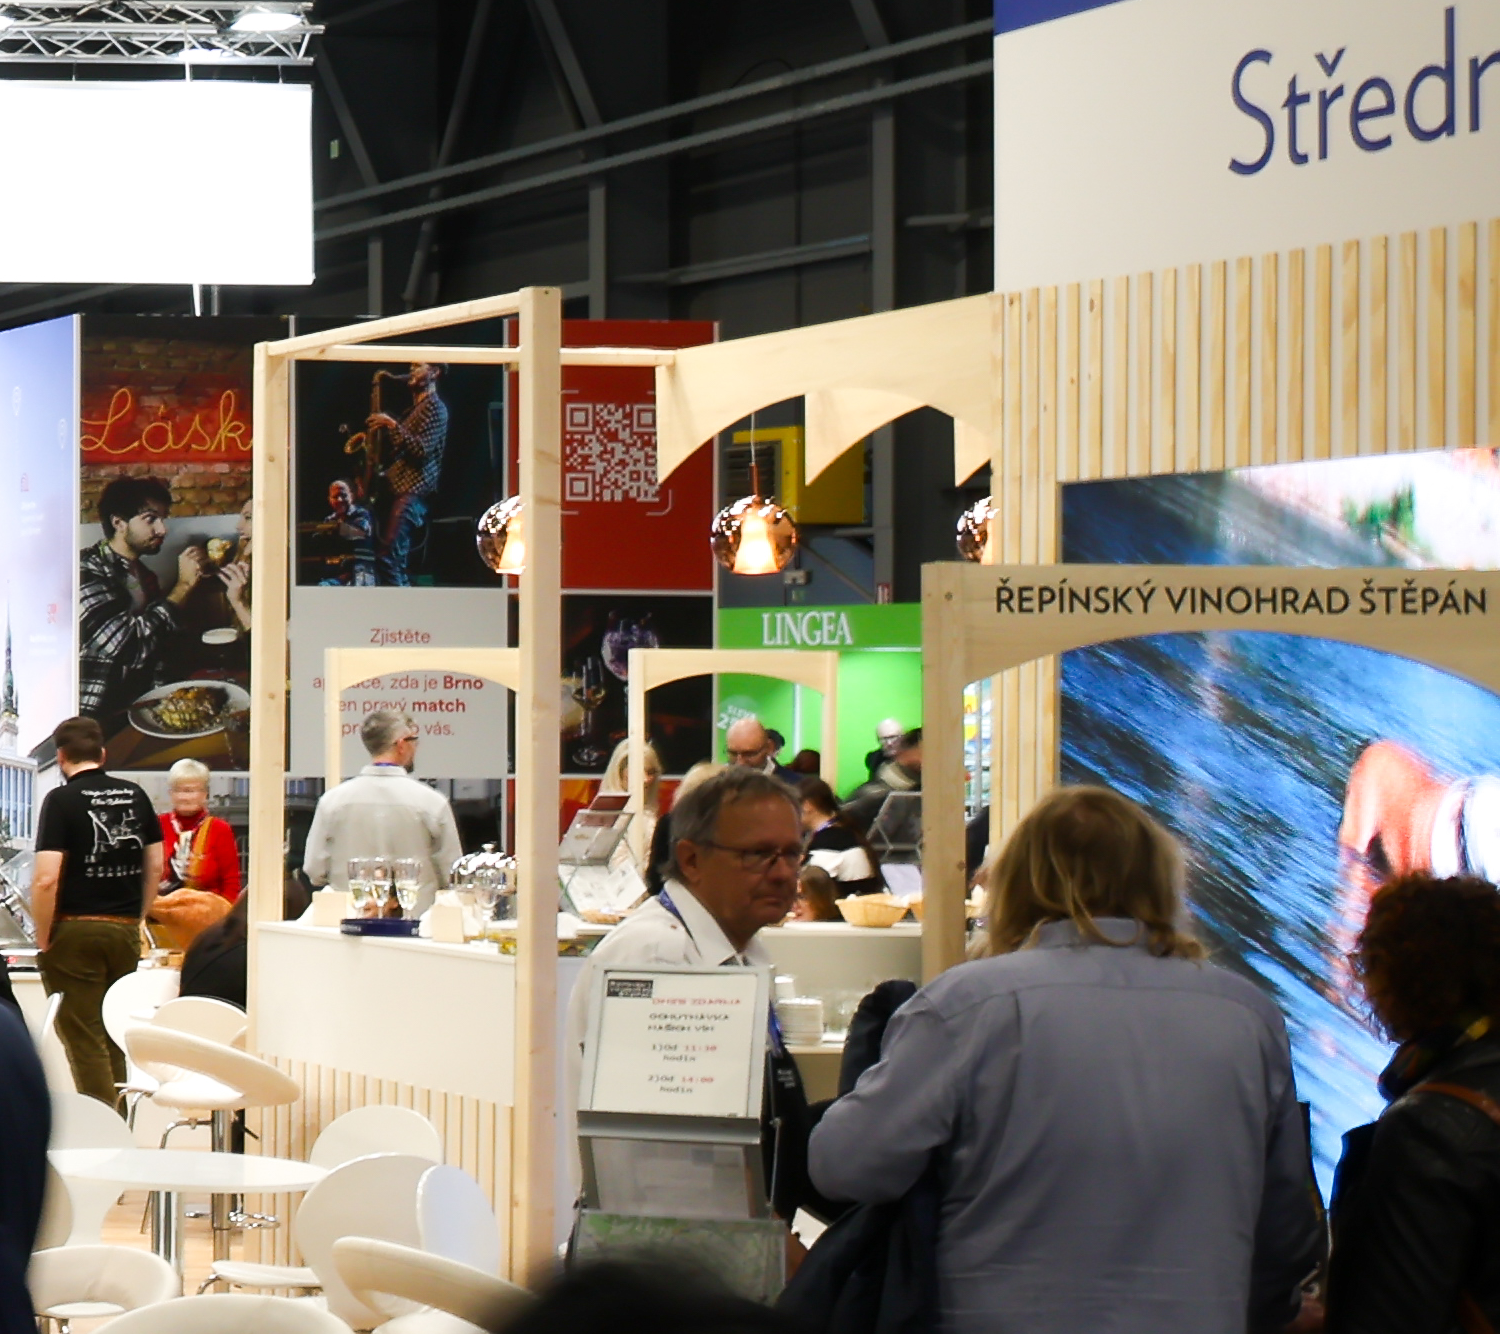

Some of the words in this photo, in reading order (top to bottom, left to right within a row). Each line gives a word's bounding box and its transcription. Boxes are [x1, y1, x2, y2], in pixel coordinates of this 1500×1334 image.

[1227, 4, 1500, 177] Středn
[80, 388, 254, 453] Lásk
[995, 576, 1157, 615] ŘEPÍNSKÝ
[1164, 585, 1350, 615] VINOHRAD
[1359, 578, 1488, 615] ŠTĚPÁN
[370, 628, 431, 646] Zjistěte
[761, 611, 854, 646] LINGEA
[389, 675, 420, 690] zda
[423, 676, 438, 693] je
[442, 675, 484, 690] Brno
[362, 698, 407, 714] pravý
[411, 699, 466, 713] match
[424, 722, 455, 736] vás.
